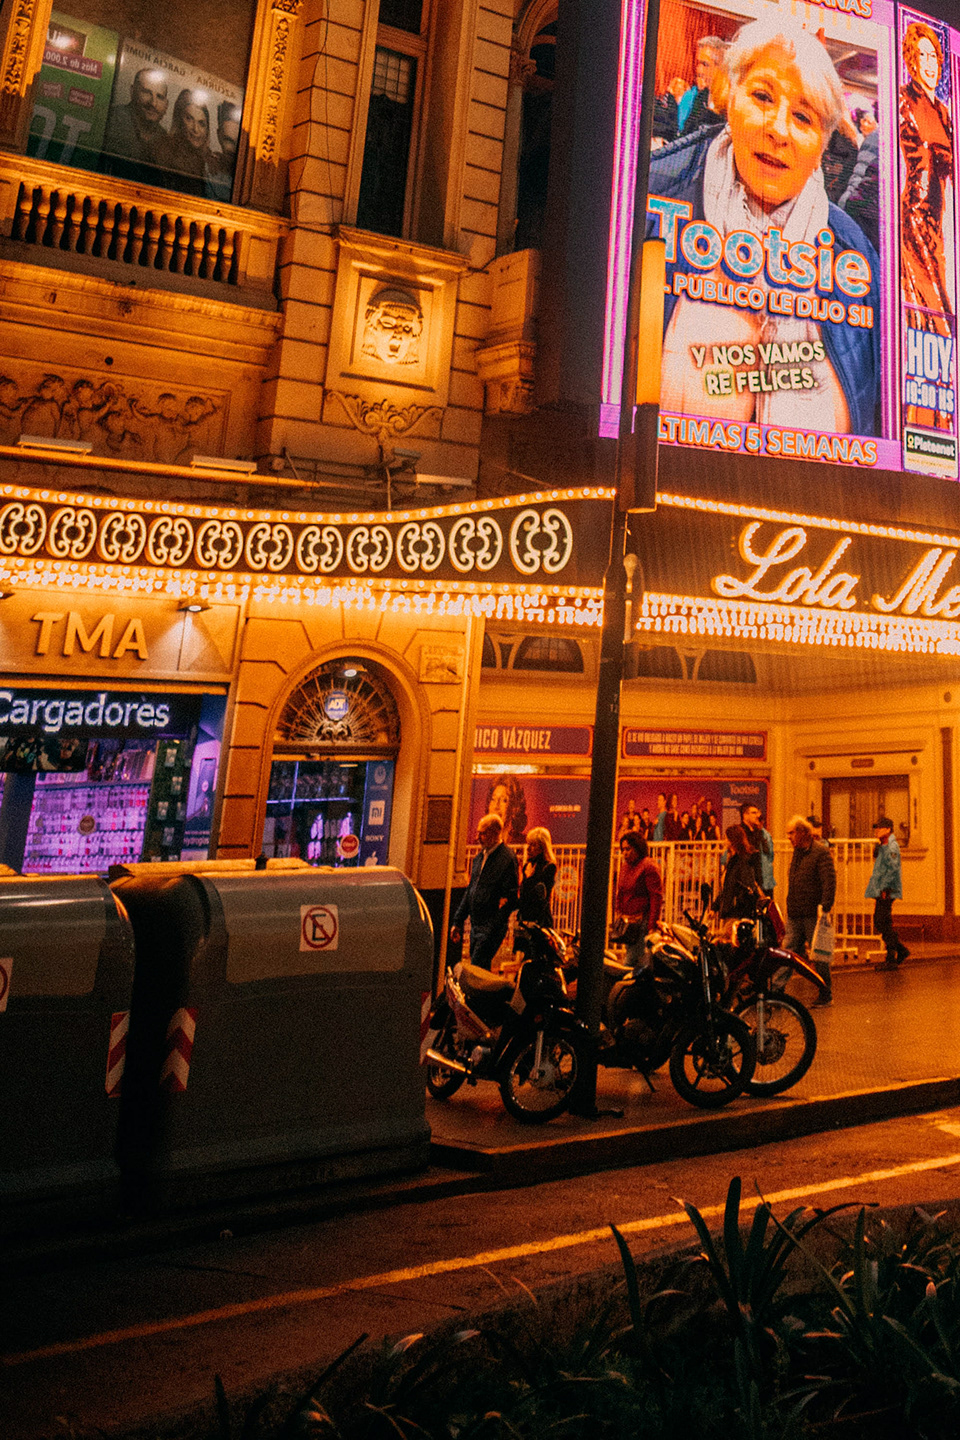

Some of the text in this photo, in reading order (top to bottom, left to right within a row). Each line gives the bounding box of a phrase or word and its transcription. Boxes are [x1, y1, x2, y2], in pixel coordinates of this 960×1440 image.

[647, 194, 872, 297] Tootsie
[769, 291, 794, 315] LE
[796, 296, 845, 324] DIJO
[691, 341, 826, 368] Y NOS VAMOS
[907, 327, 953, 384] HOY
[706, 367, 819, 395] RE FELICES.
[938, 386, 954, 414] HS
[658, 415, 742, 449] LTIMAS
[747, 426, 762, 451] 5
[766, 429, 878, 465] SEMANAS
[711, 522, 860, 609] Lola
[31, 611, 150, 660] TMA
[0, 690, 170, 733] Cargadores
[327, 697, 345, 711] ADT
[474, 726, 551, 752] ICO VÁZQUEZ
